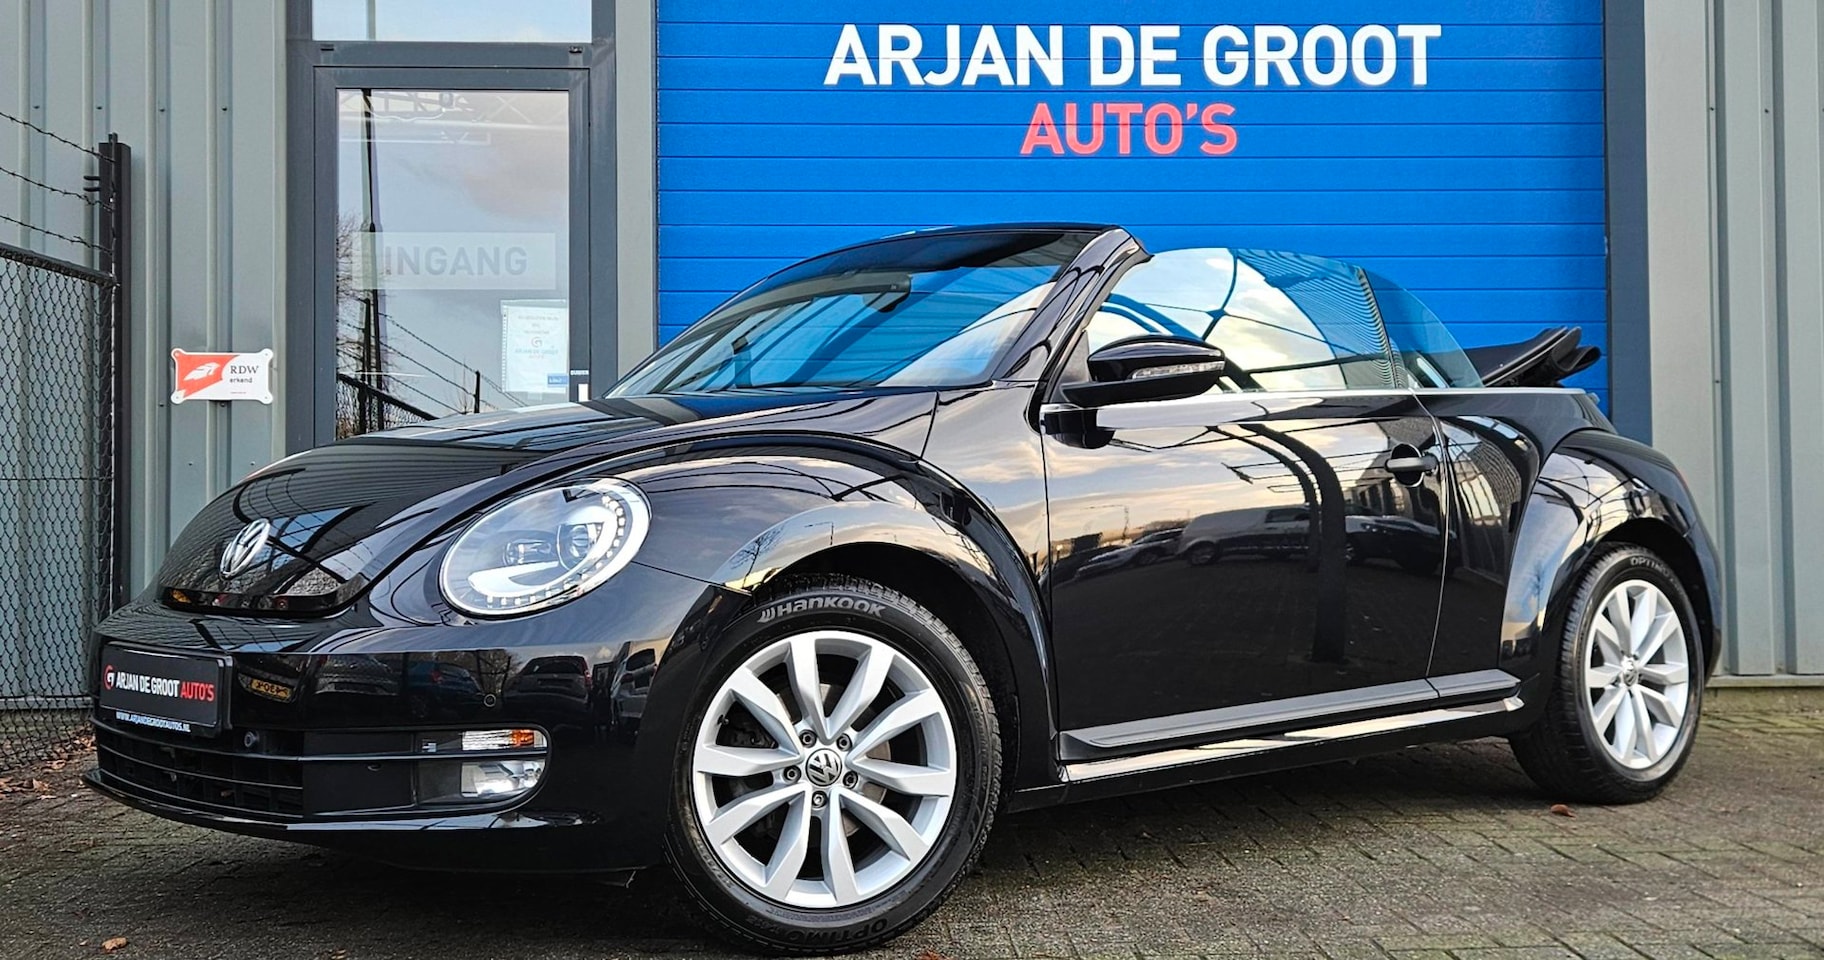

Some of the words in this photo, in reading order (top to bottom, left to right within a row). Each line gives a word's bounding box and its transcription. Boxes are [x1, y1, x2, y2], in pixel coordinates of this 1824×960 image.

[823, 24, 1064, 87] ARJAN
[1090, 24, 1181, 86] DE
[1203, 24, 1442, 87] GROOT
[1020, 102, 1238, 155] AUTO'S
[383, 246, 528, 276] INGANG
[230, 365, 258, 375] RDW
[116, 671, 139, 691] ARJAN
[139, 675, 151, 694] DE
[151, 677, 180, 698] GROOT
[180, 681, 215, 702] AUTO'S
